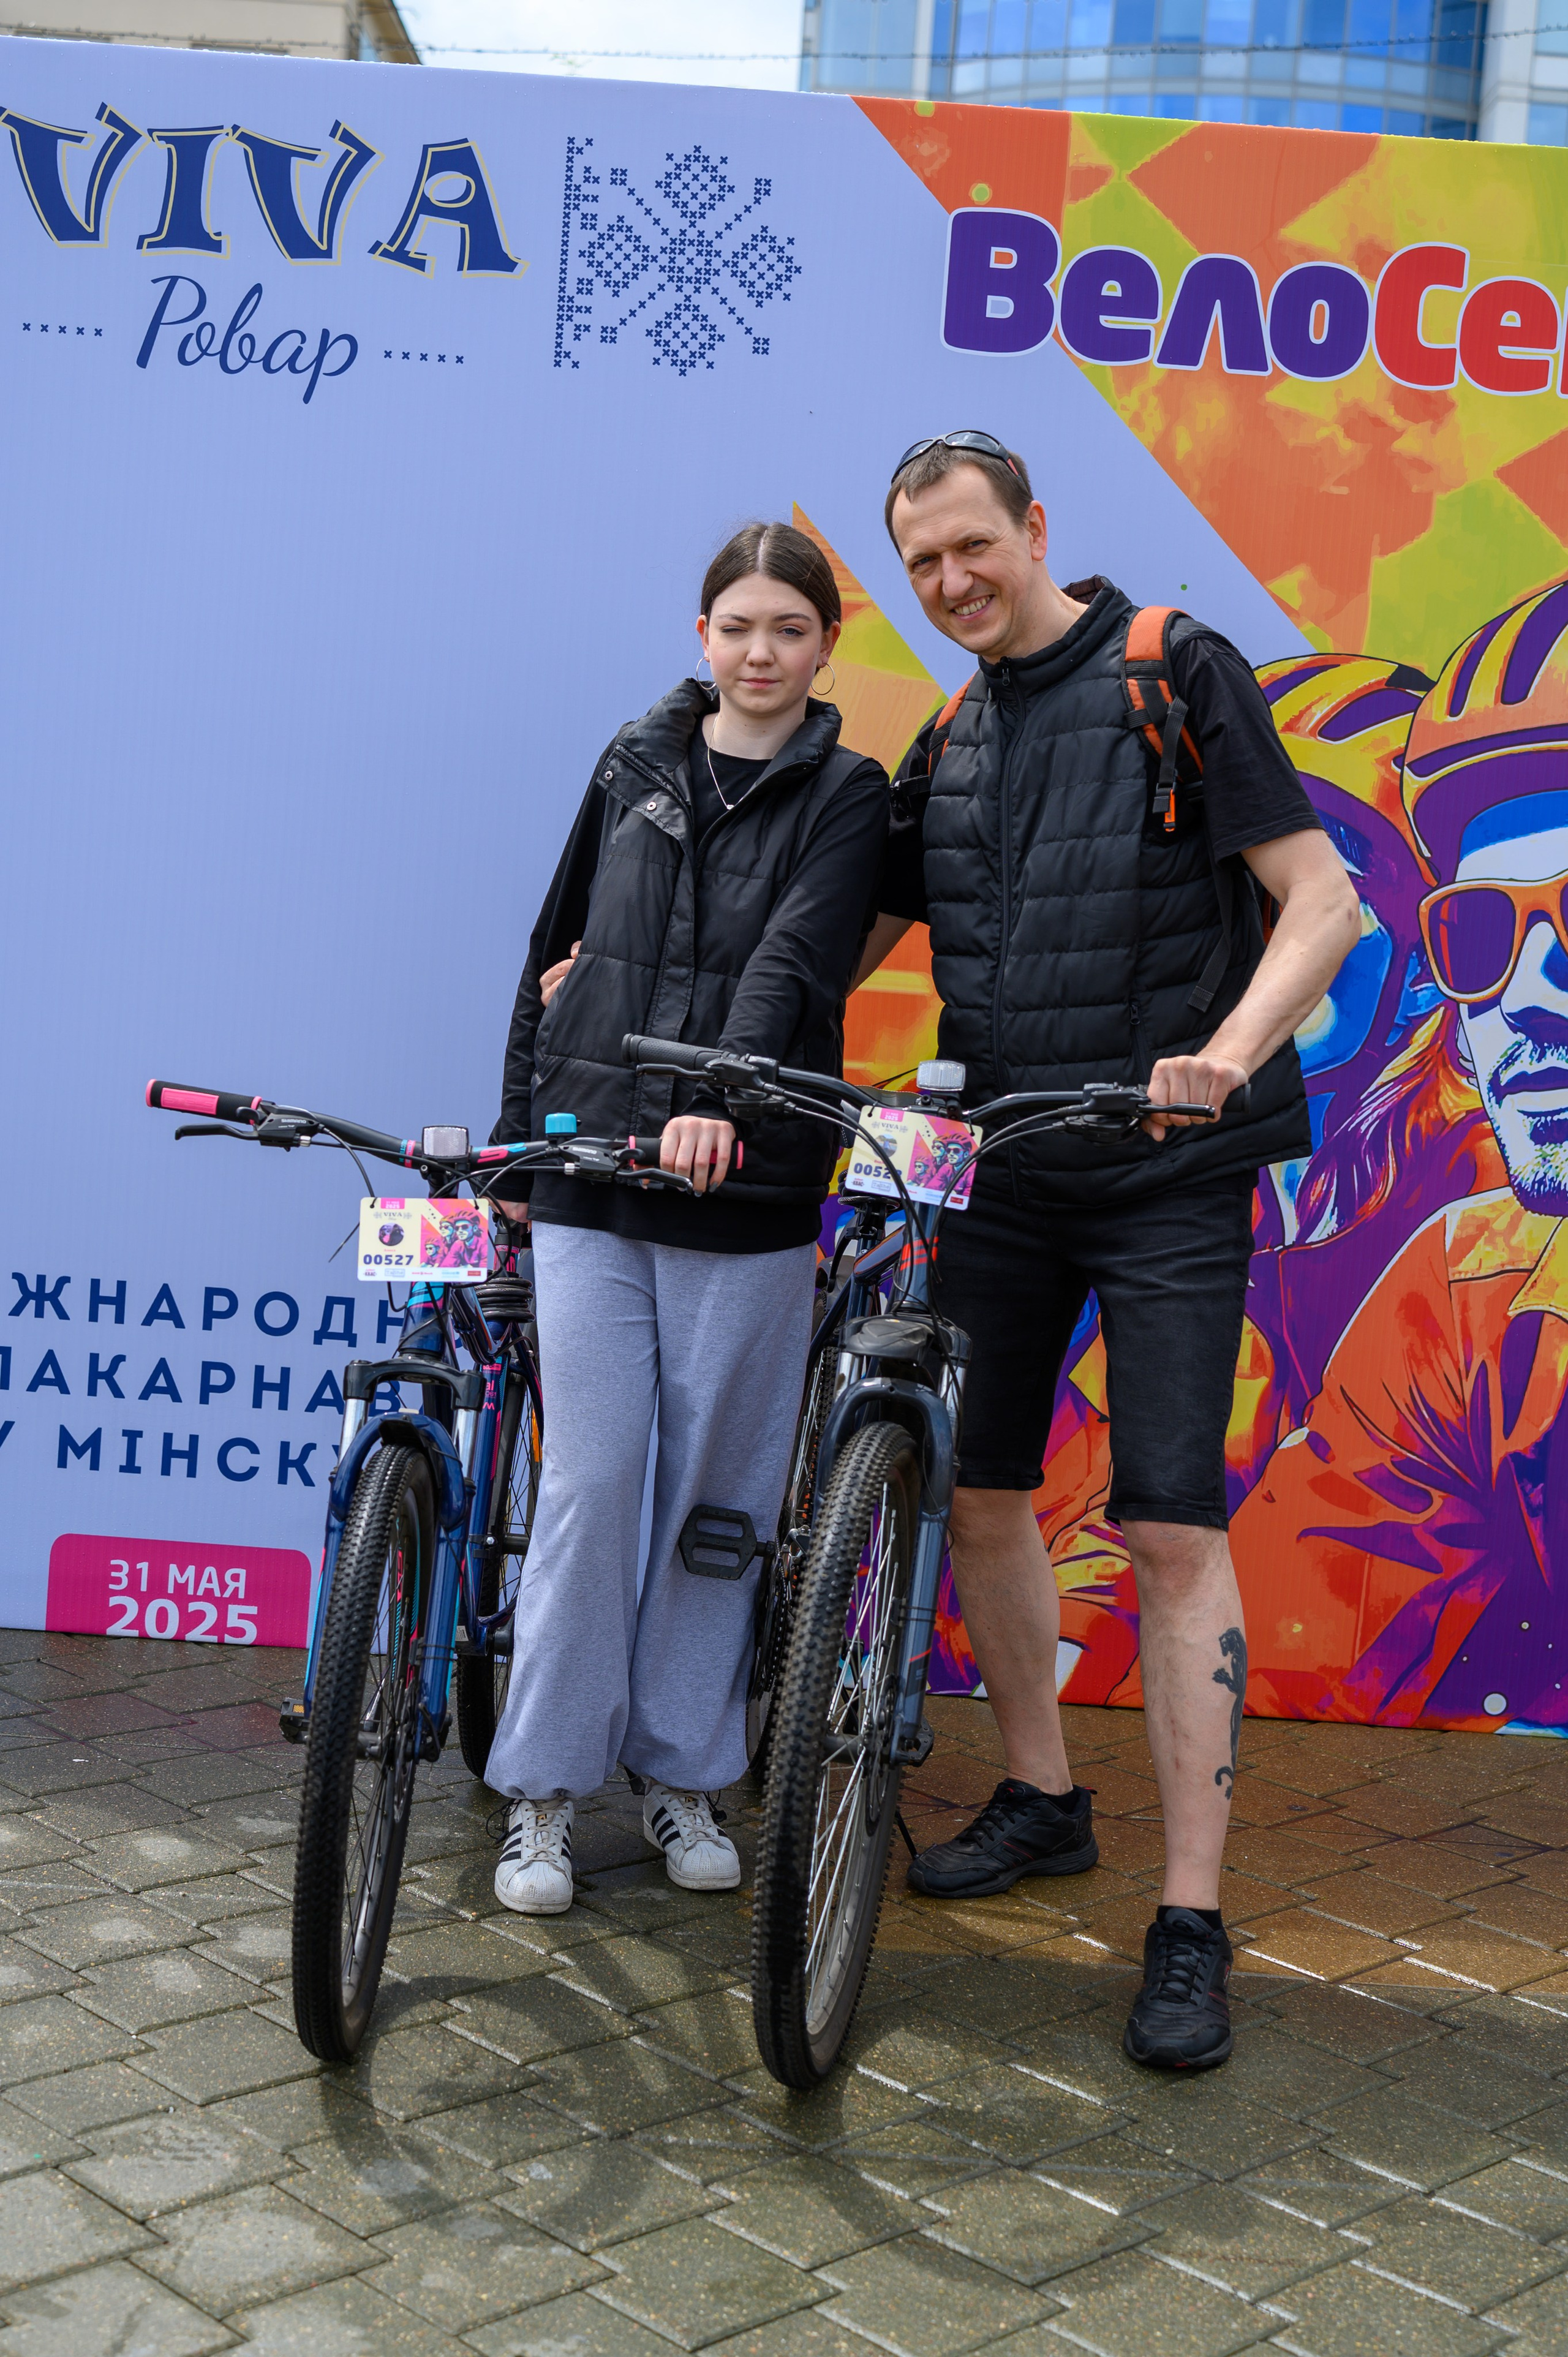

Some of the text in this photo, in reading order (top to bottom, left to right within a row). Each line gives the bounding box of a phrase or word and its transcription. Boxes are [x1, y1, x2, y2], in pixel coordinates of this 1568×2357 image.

[0, 102, 530, 279] VIVA
[940, 207, 1568, 399] ВелоСе
[136, 275, 359, 405] Ровар
[363, 1254, 414, 1265] 00527
[8, 1272, 470, 1349] ЖНАРОДН
[0, 1346, 448, 1418] АКАРНАВ
[57, 1424, 340, 1487] МІНСК
[108, 1559, 246, 1599] 31 МАЯ
[106, 1595, 258, 1645] 2025
